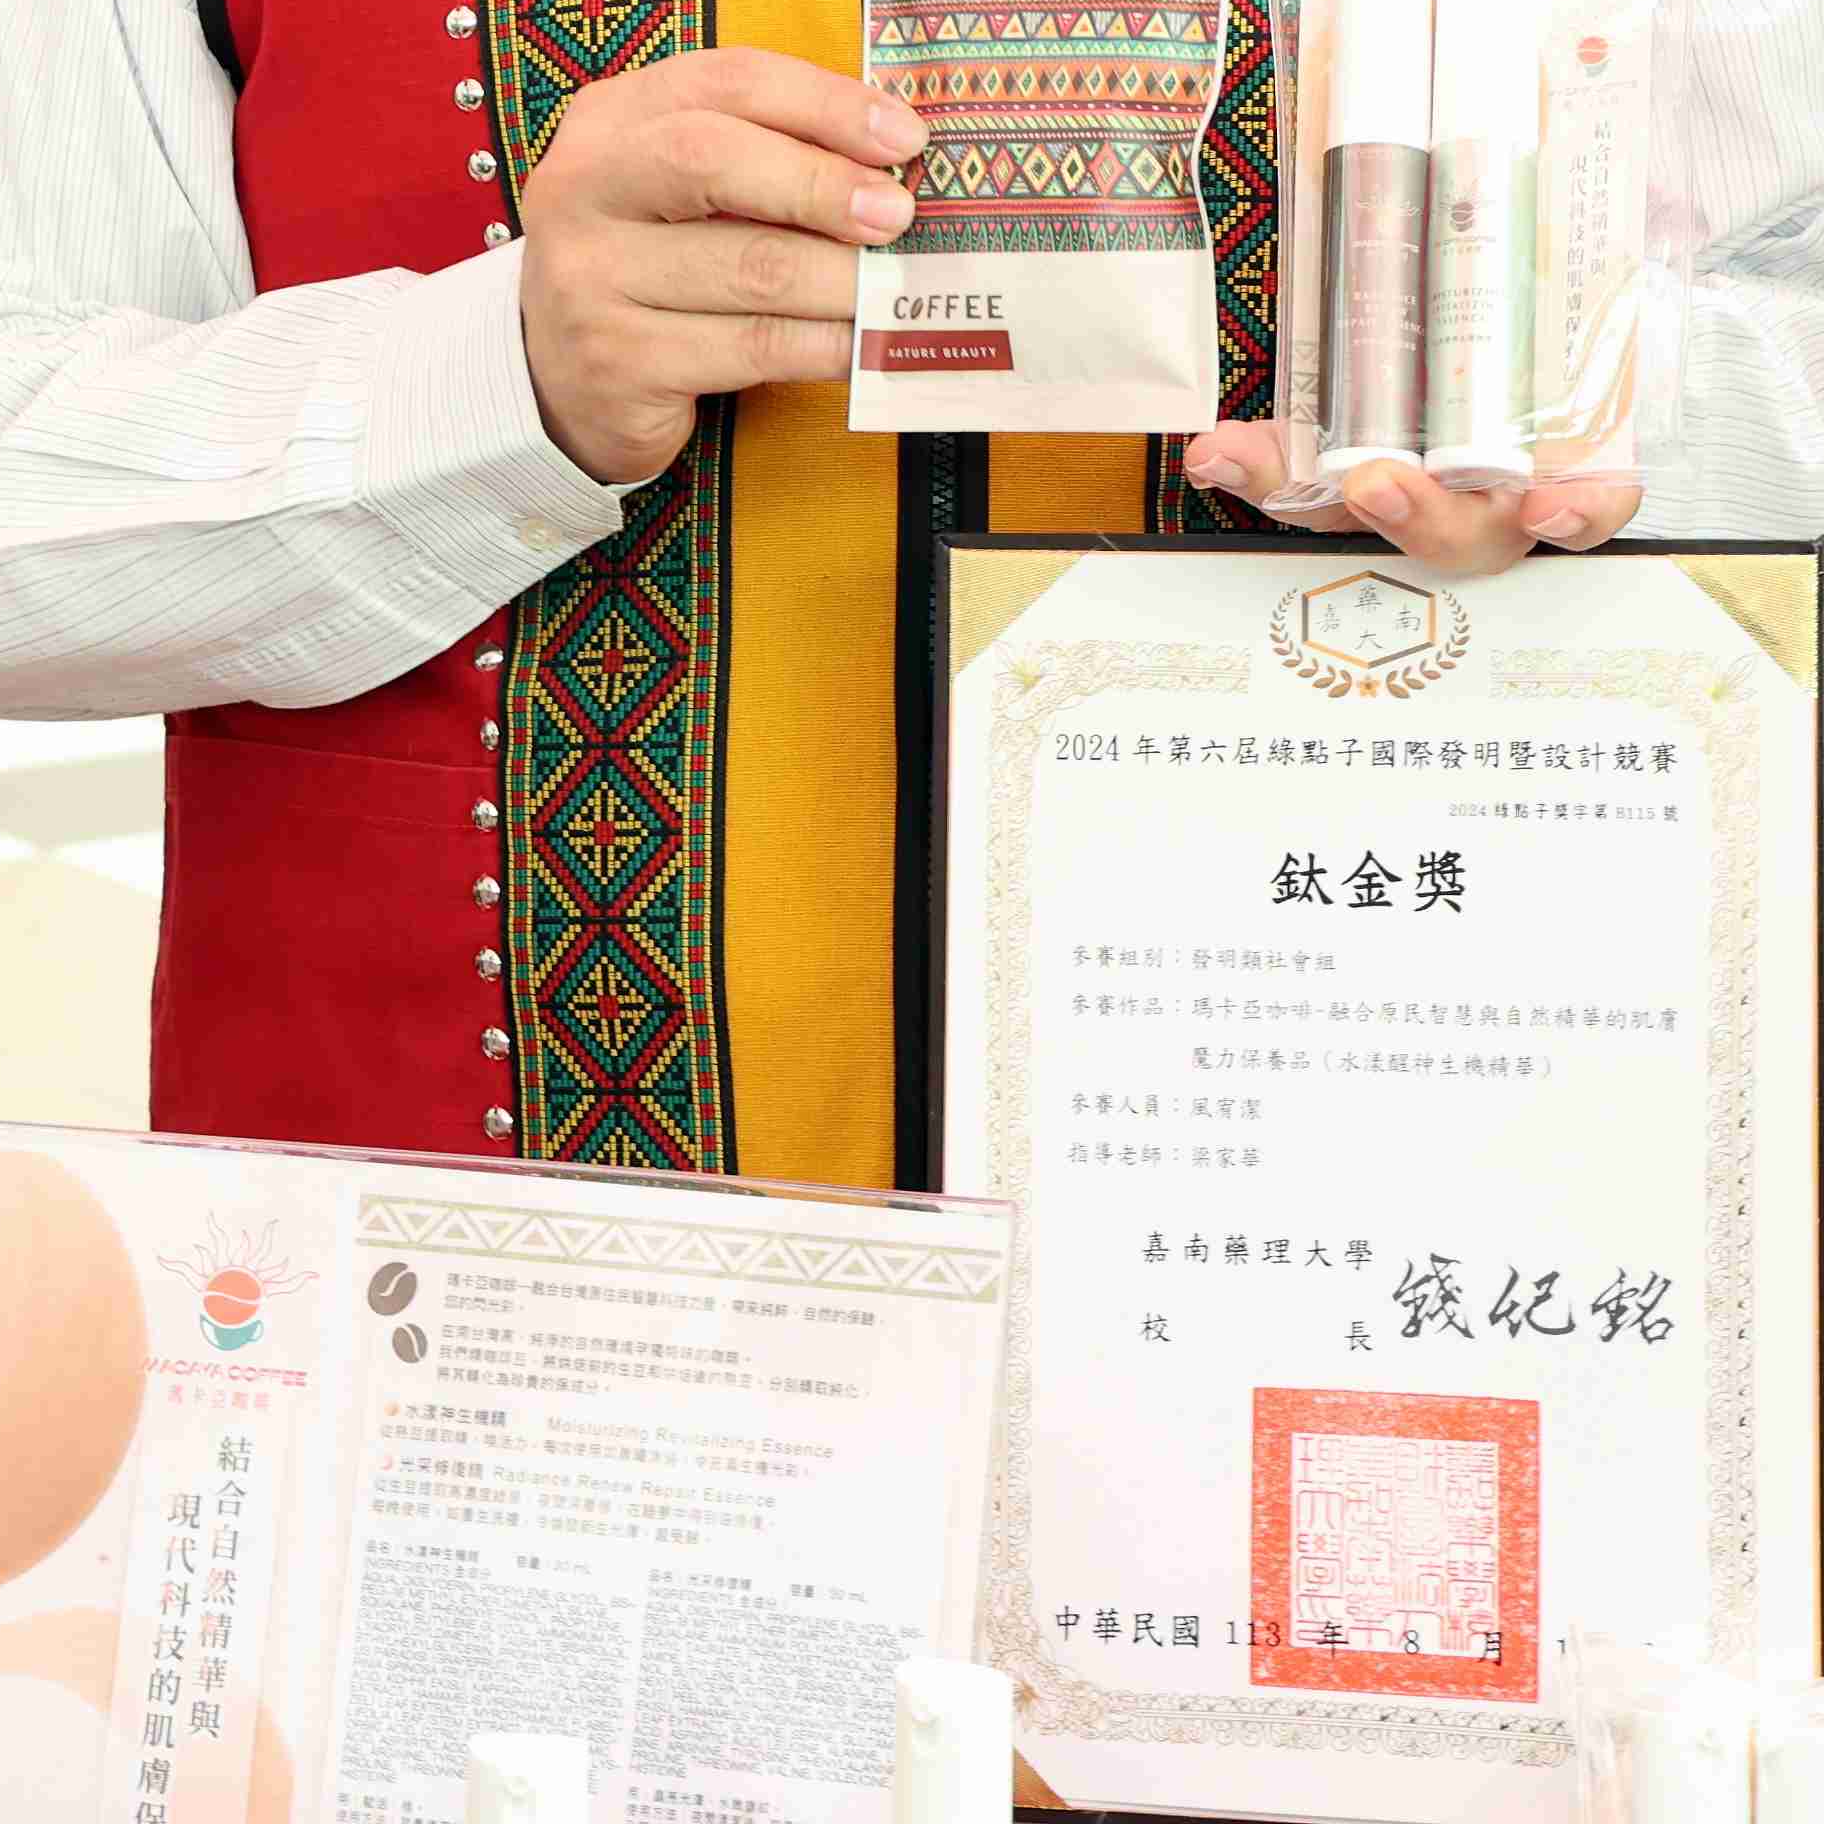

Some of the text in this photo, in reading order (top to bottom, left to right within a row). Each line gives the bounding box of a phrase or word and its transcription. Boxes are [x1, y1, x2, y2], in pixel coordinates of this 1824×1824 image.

[893, 295, 1004, 320] COFFEE
[888, 345, 997, 359] NATURE BEAUTY
[1395, 603, 1421, 632] 南
[1355, 629, 1384, 650] 大
[1055, 731, 1121, 764] 2024
[1269, 849, 1466, 914] 鈦金獎
[1140, 1231, 1375, 1272] 嘉南藥理大學
[1392, 1253, 1677, 1345] 錢紀銘
[1139, 1313, 1374, 1352] 校 長
[188, 1433, 253, 1740] 結合自然精華與
[1054, 1605, 1201, 1651] 中華民國
[1225, 1619, 1281, 1651] 113
[1316, 1620, 1350, 1658] 年
[1404, 1629, 1420, 1656] 8
[1478, 1631, 1503, 1667] 月
